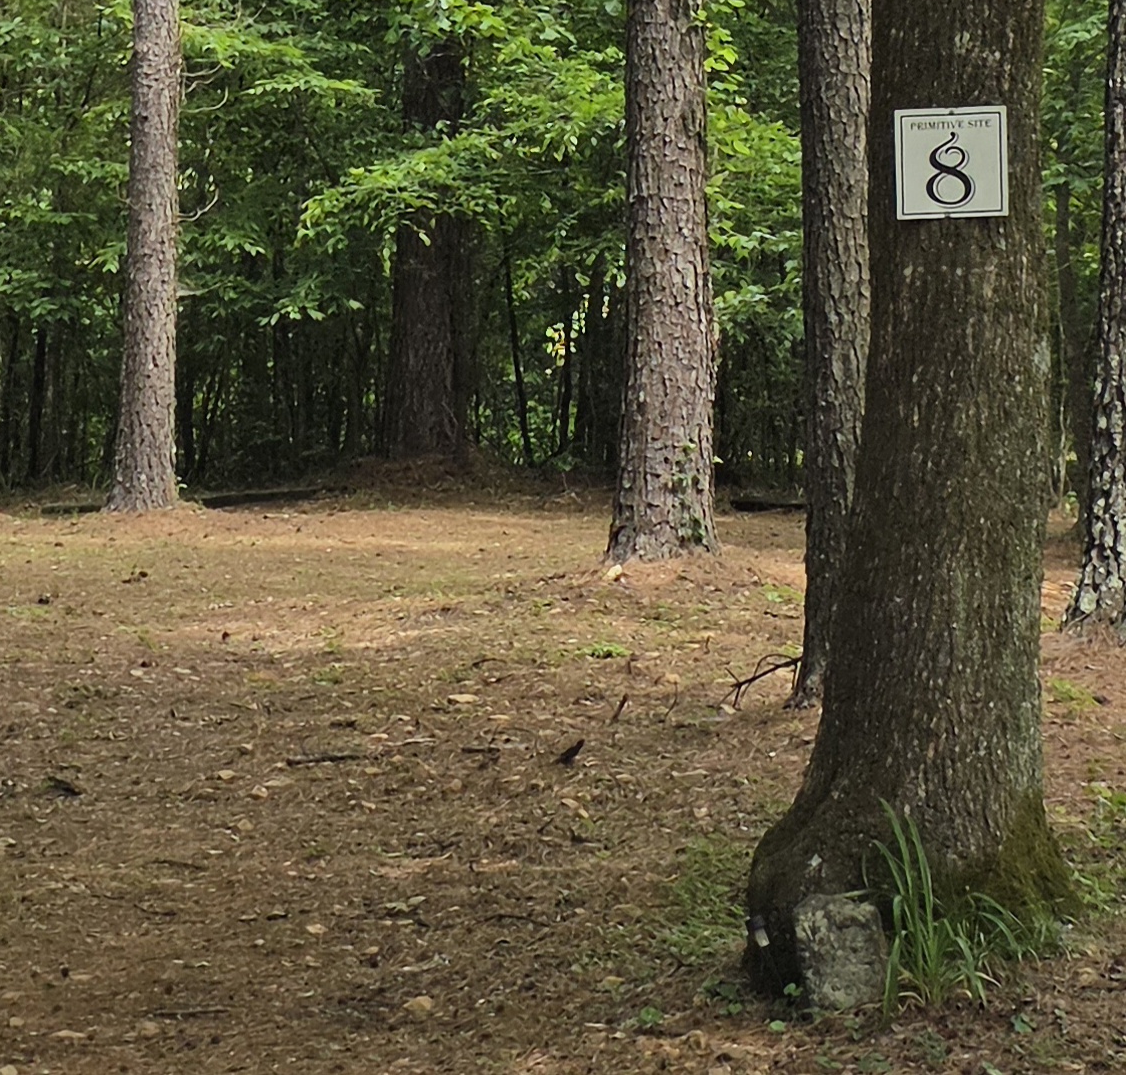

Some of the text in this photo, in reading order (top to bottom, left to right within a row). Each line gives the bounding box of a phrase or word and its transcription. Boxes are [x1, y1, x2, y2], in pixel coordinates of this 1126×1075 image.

[910, 119, 992, 131] PRIMITIVE SITE
[926, 131, 974, 207] 8
